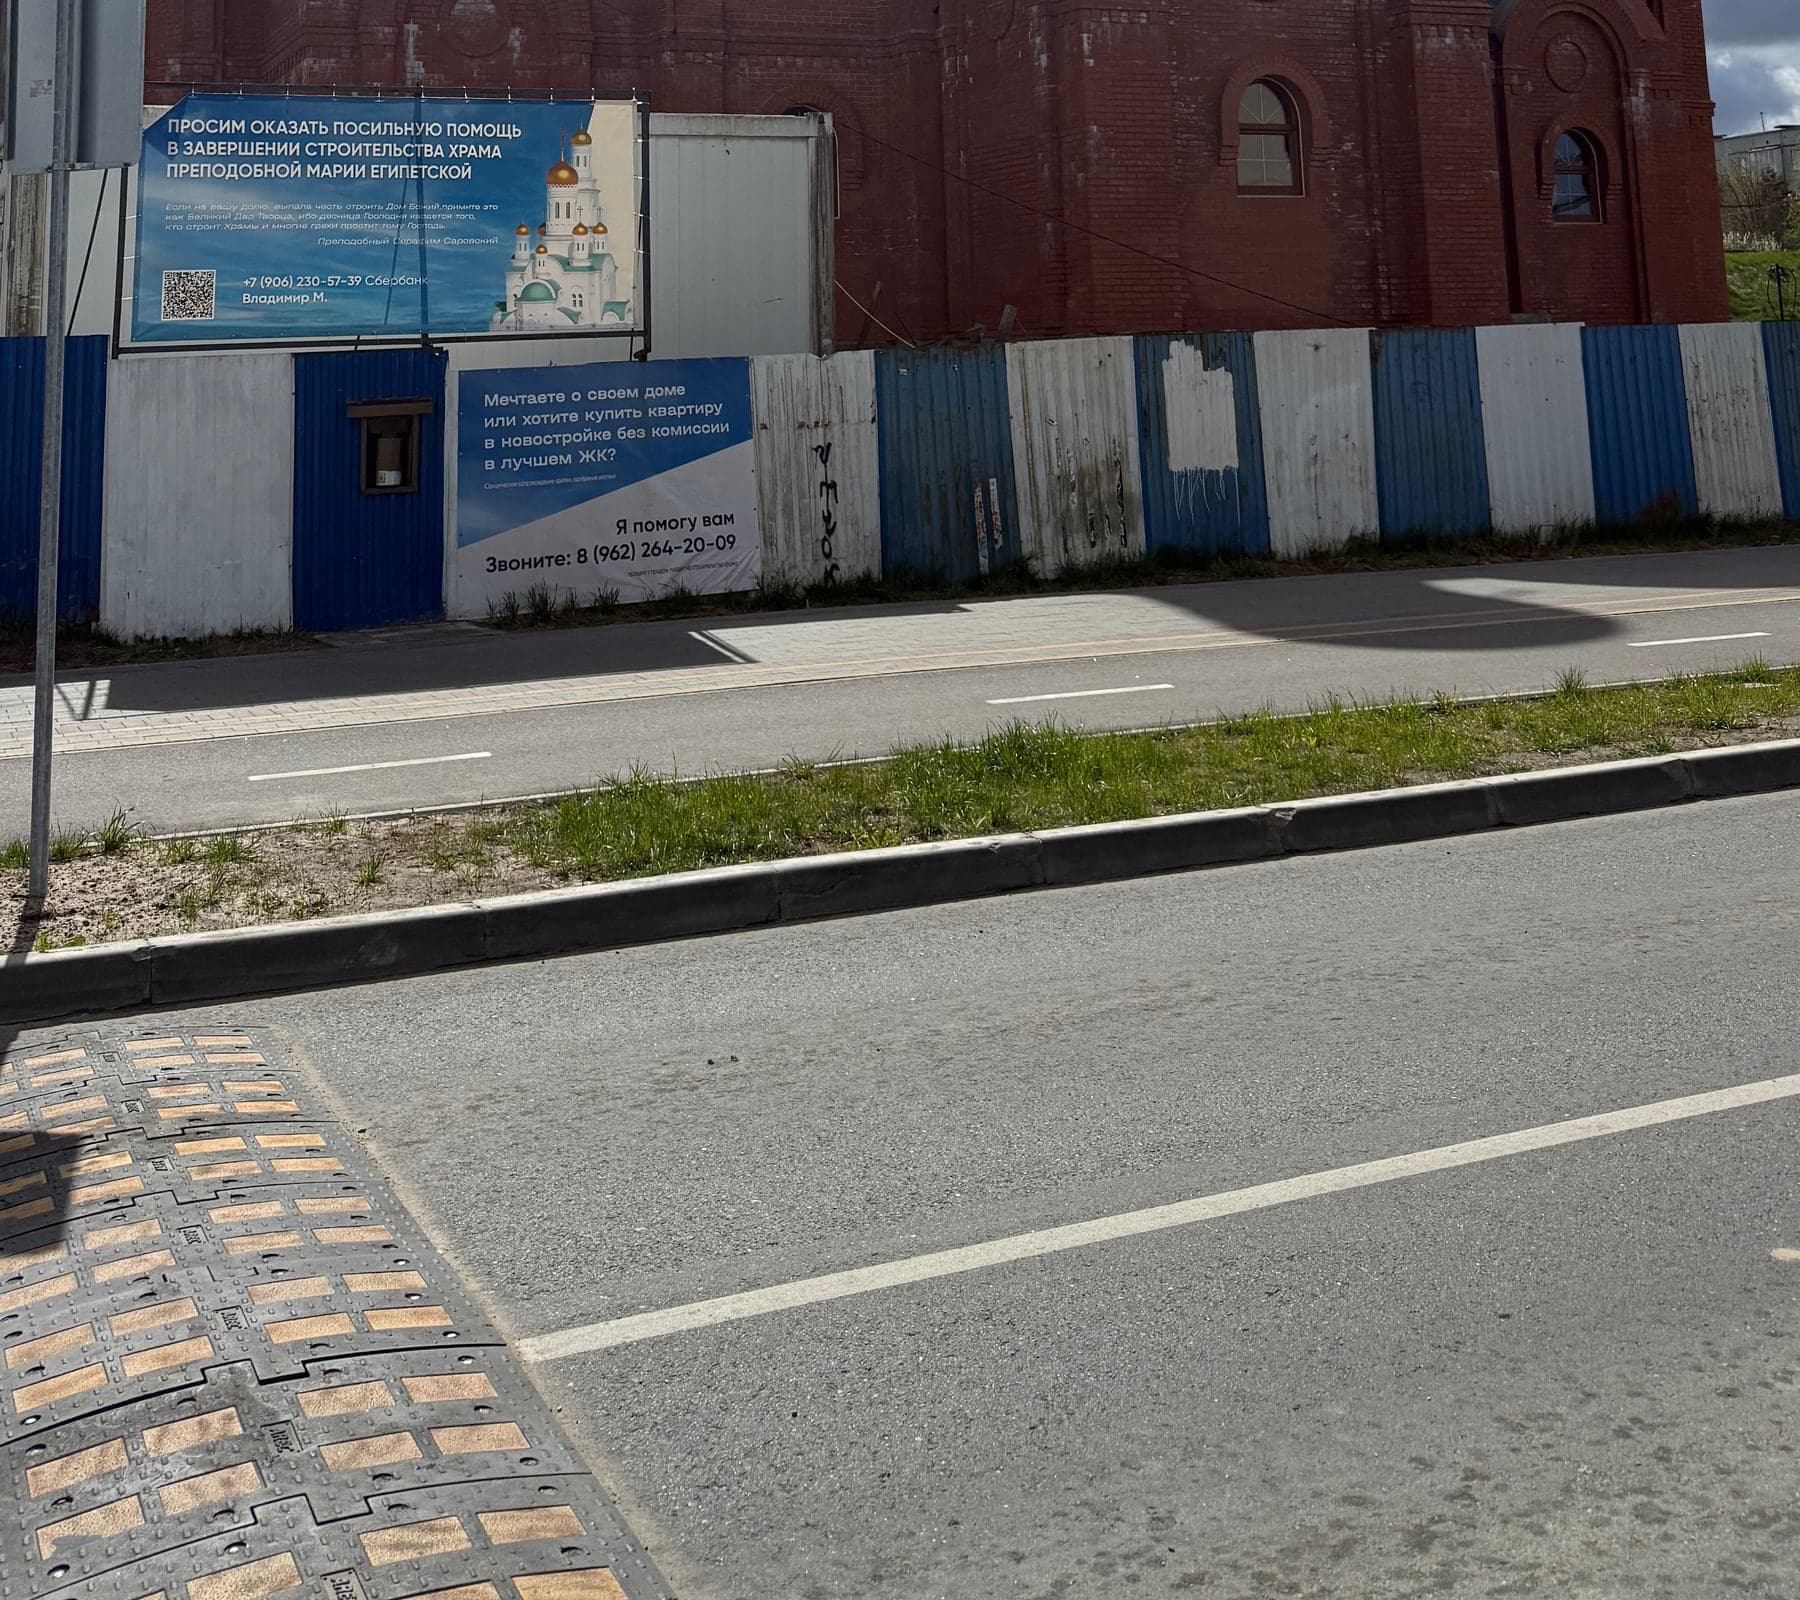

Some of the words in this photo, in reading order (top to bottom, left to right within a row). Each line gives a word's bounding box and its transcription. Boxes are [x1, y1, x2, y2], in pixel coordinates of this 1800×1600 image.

[168, 119, 245, 134] ПРОСИМ
[251, 120, 328, 135] ОКАЗАТЬ
[333, 121, 442, 137] ПОСИЛЬНУЮ
[447, 122, 521, 139] ПОМОЩЬ
[167, 141, 178, 156] В
[183, 141, 300, 157] ЗАВЕРШЕНИИ
[305, 142, 444, 158] СТРОИТЕЛЬСТВА
[449, 144, 502, 159] ХРАМА
[166, 161, 301, 180] ПРЕПОДОБНОЙ
[306, 163, 366, 179] МАРИИ
[371, 162, 472, 180] ЕГИПЕТСКОЙ
[242, 277, 256, 288] +7
[260, 275, 293, 289] (906)
[296, 275, 362, 288] 230-57-39
[364, 275, 430, 289] Сбербанк
[242, 293, 309, 305] Владимир
[313, 292, 328, 303] М.
[484, 391, 565, 407] Мечтаете
[571, 391, 581, 402] о
[587, 387, 639, 401] своем
[644, 385, 686, 400] доме
[484, 415, 516, 428] или
[522, 412, 579, 426] хотите
[585, 407, 642, 423] купить
[648, 402, 723, 418] квартиру
[484, 438, 495, 449] в
[501, 428, 612, 448] новостройке
[617, 426, 646, 440] без
[651, 422, 730, 438] комиссии
[484, 459, 495, 470] в
[500, 453, 572, 472] лучшем
[578, 448, 616, 464] ЖК?
[616, 519, 627, 535] Я
[633, 516, 697, 533] помогу
[702, 512, 735, 527] вам
[485, 552, 571, 573] Звоните:
[576, 547, 588, 564] 8
[593, 540, 636, 565] (962)
[641, 534, 737, 558] 264-20-09
